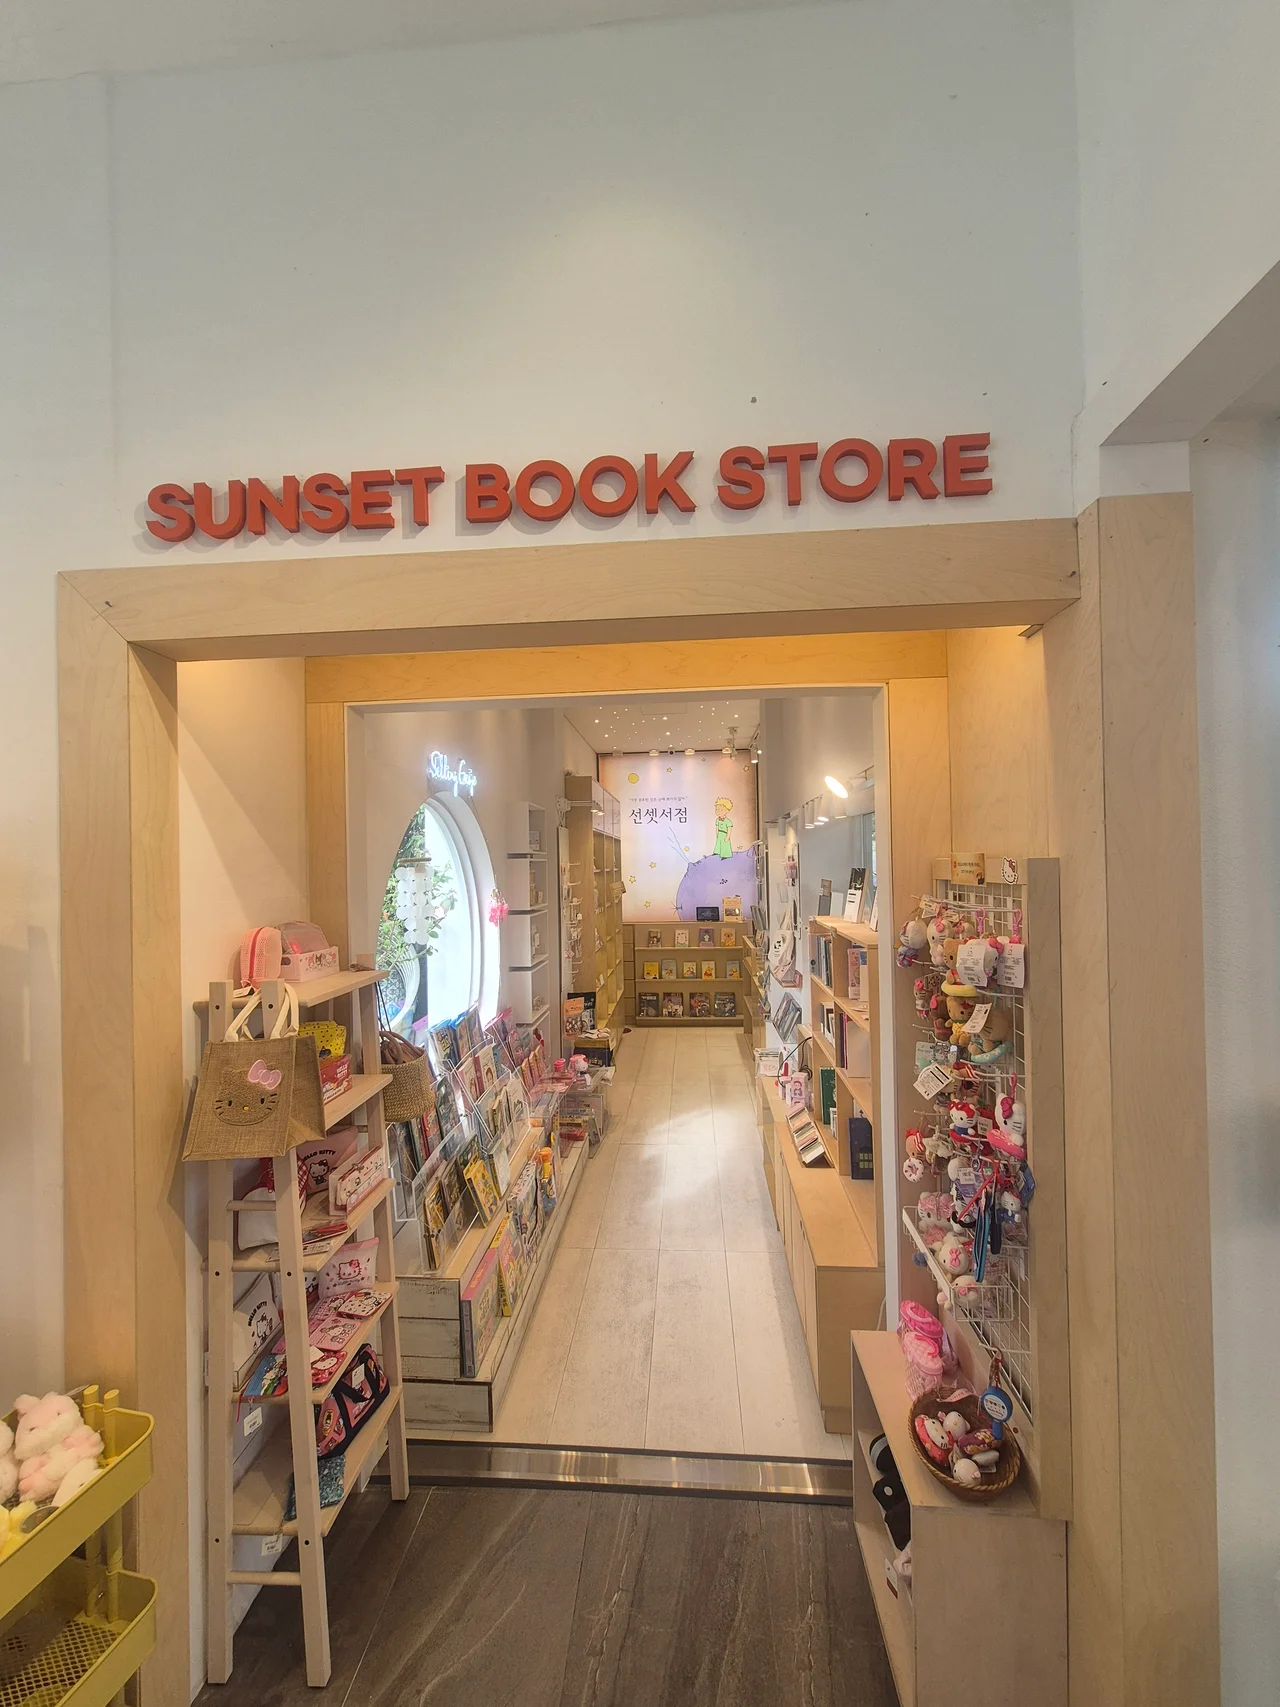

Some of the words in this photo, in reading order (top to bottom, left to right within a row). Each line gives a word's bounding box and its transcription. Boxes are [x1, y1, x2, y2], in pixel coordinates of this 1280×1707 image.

[146, 466, 446, 543] SUNSET
[465, 451, 697, 524] BOOK
[718, 432, 994, 511] STORE
[628, 806, 688, 825] 선셋서점
